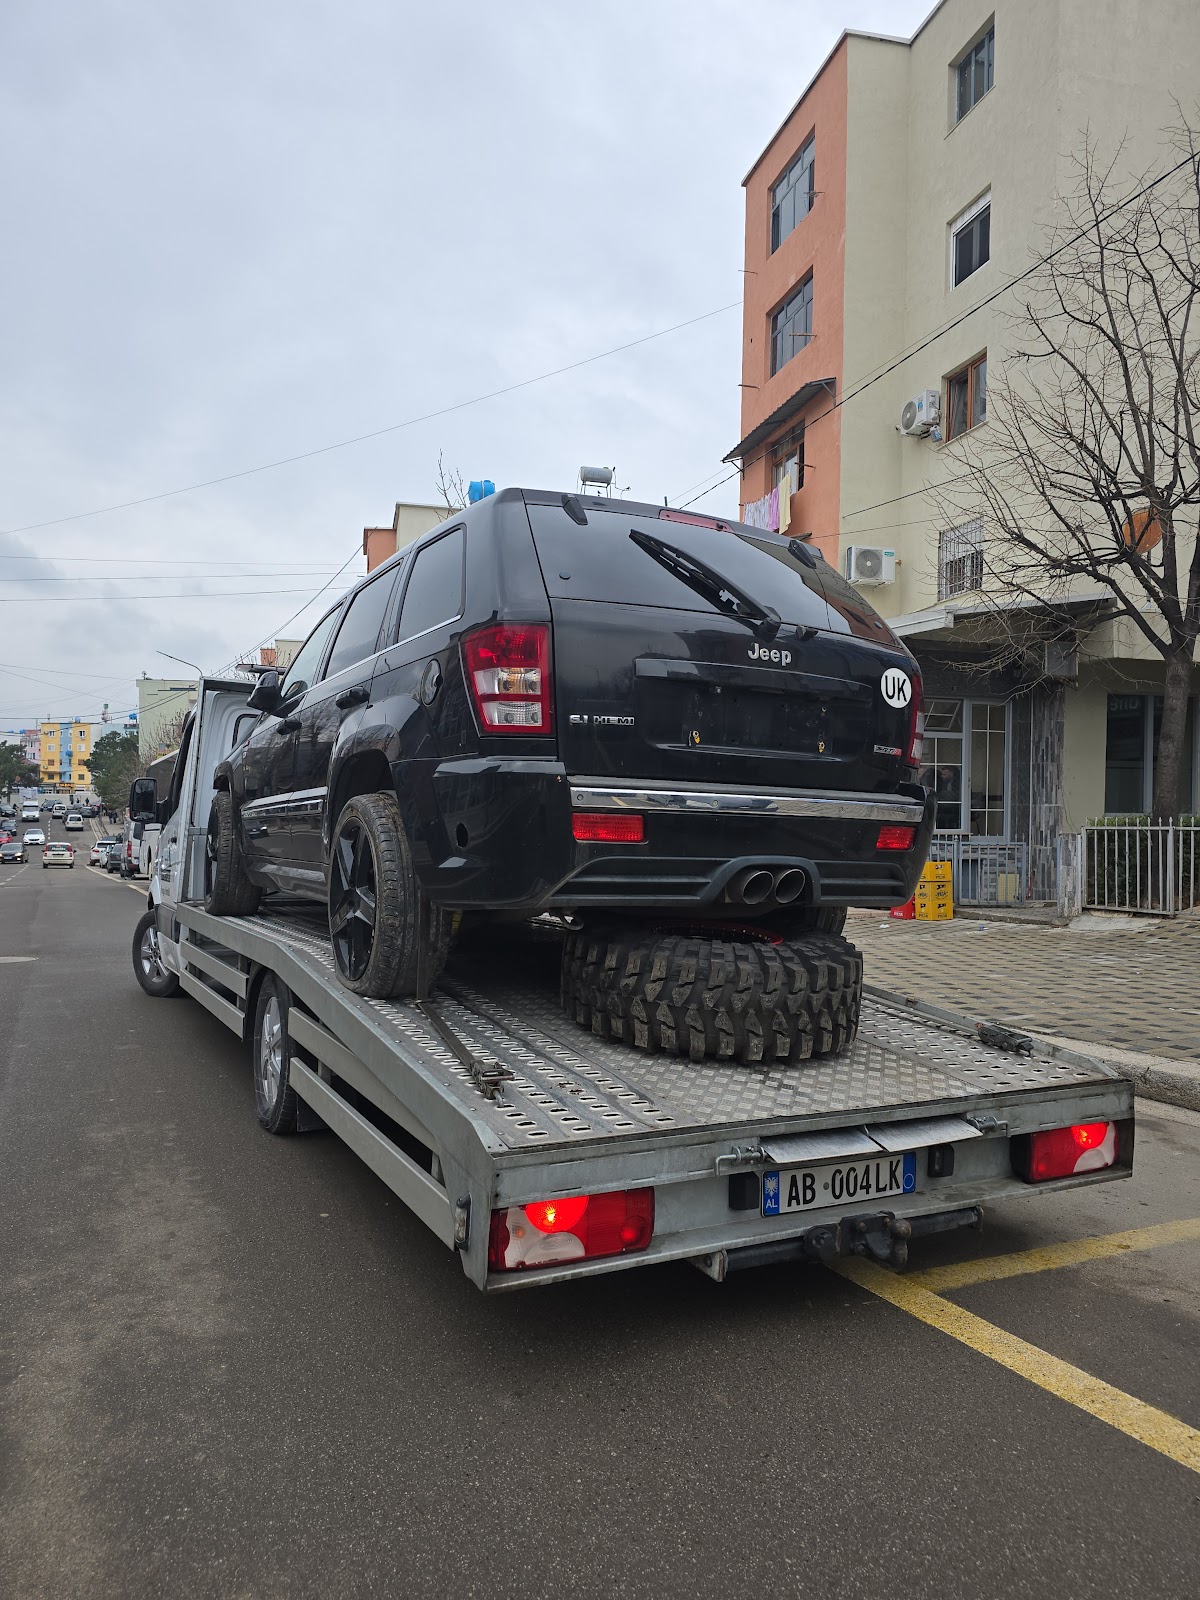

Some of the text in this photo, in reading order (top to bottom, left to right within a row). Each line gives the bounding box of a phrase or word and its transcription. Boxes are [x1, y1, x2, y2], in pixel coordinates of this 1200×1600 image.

[747, 642, 792, 667] Jeep
[885, 674, 908, 702] UK
[569, 714, 635, 726] 6.1 HEMI
[787, 1172, 816, 1208] AB
[765, 1198, 778, 1209] AL
